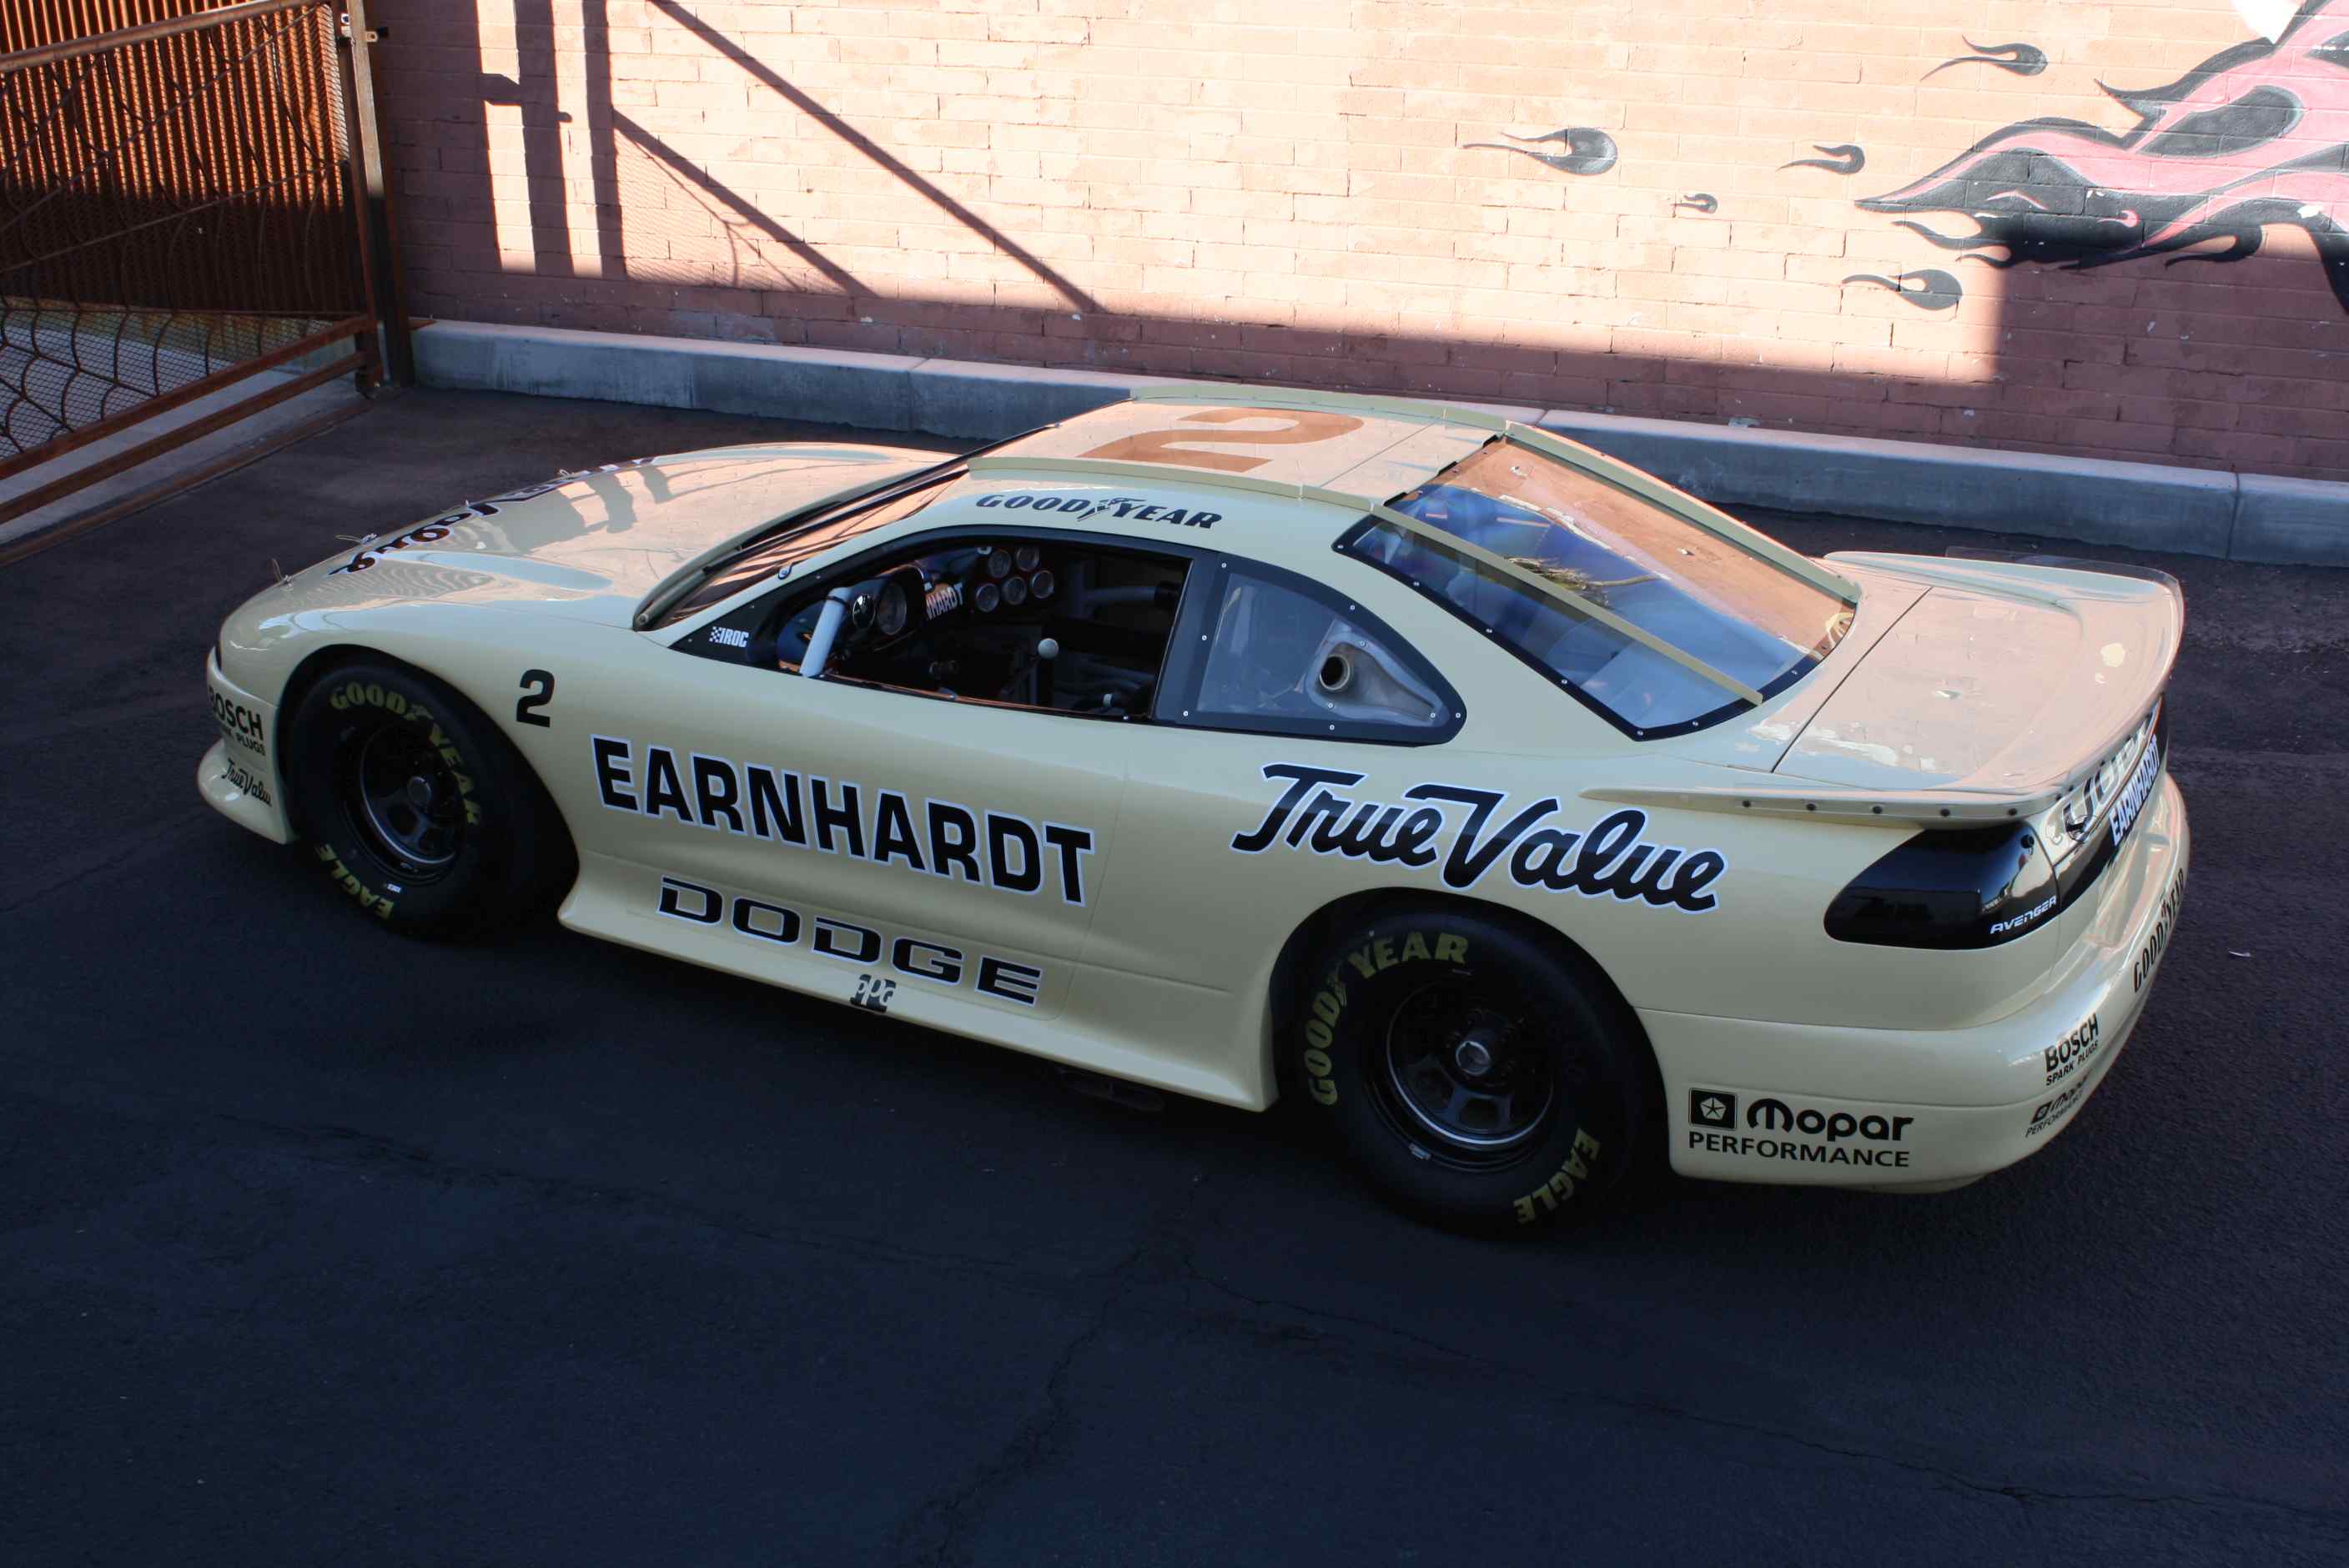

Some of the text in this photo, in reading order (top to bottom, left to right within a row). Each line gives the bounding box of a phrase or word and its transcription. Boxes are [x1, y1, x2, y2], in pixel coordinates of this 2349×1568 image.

[1075, 406, 1365, 473] 2
[719, 626, 750, 648] IROC
[209, 686, 264, 741] OSCH
[516, 668, 556, 728] 2
[221, 757, 244, 789] True
[2109, 732, 2161, 847] EARNHARDT
[591, 733, 1095, 907] EARNHARDT
[1231, 763, 1728, 915] True Value
[314, 842, 395, 919] EAGLE
[656, 875, 1044, 1008] DODGE
[1989, 894, 2057, 935] AVENGER
[2045, 1013, 2100, 1073] BOSCH
[2046, 1041, 2099, 1086] SPARK PLUGS
[1512, 1127, 1602, 1224] EAGLE
[1688, 1130, 1910, 1168] PERFORMANCE
